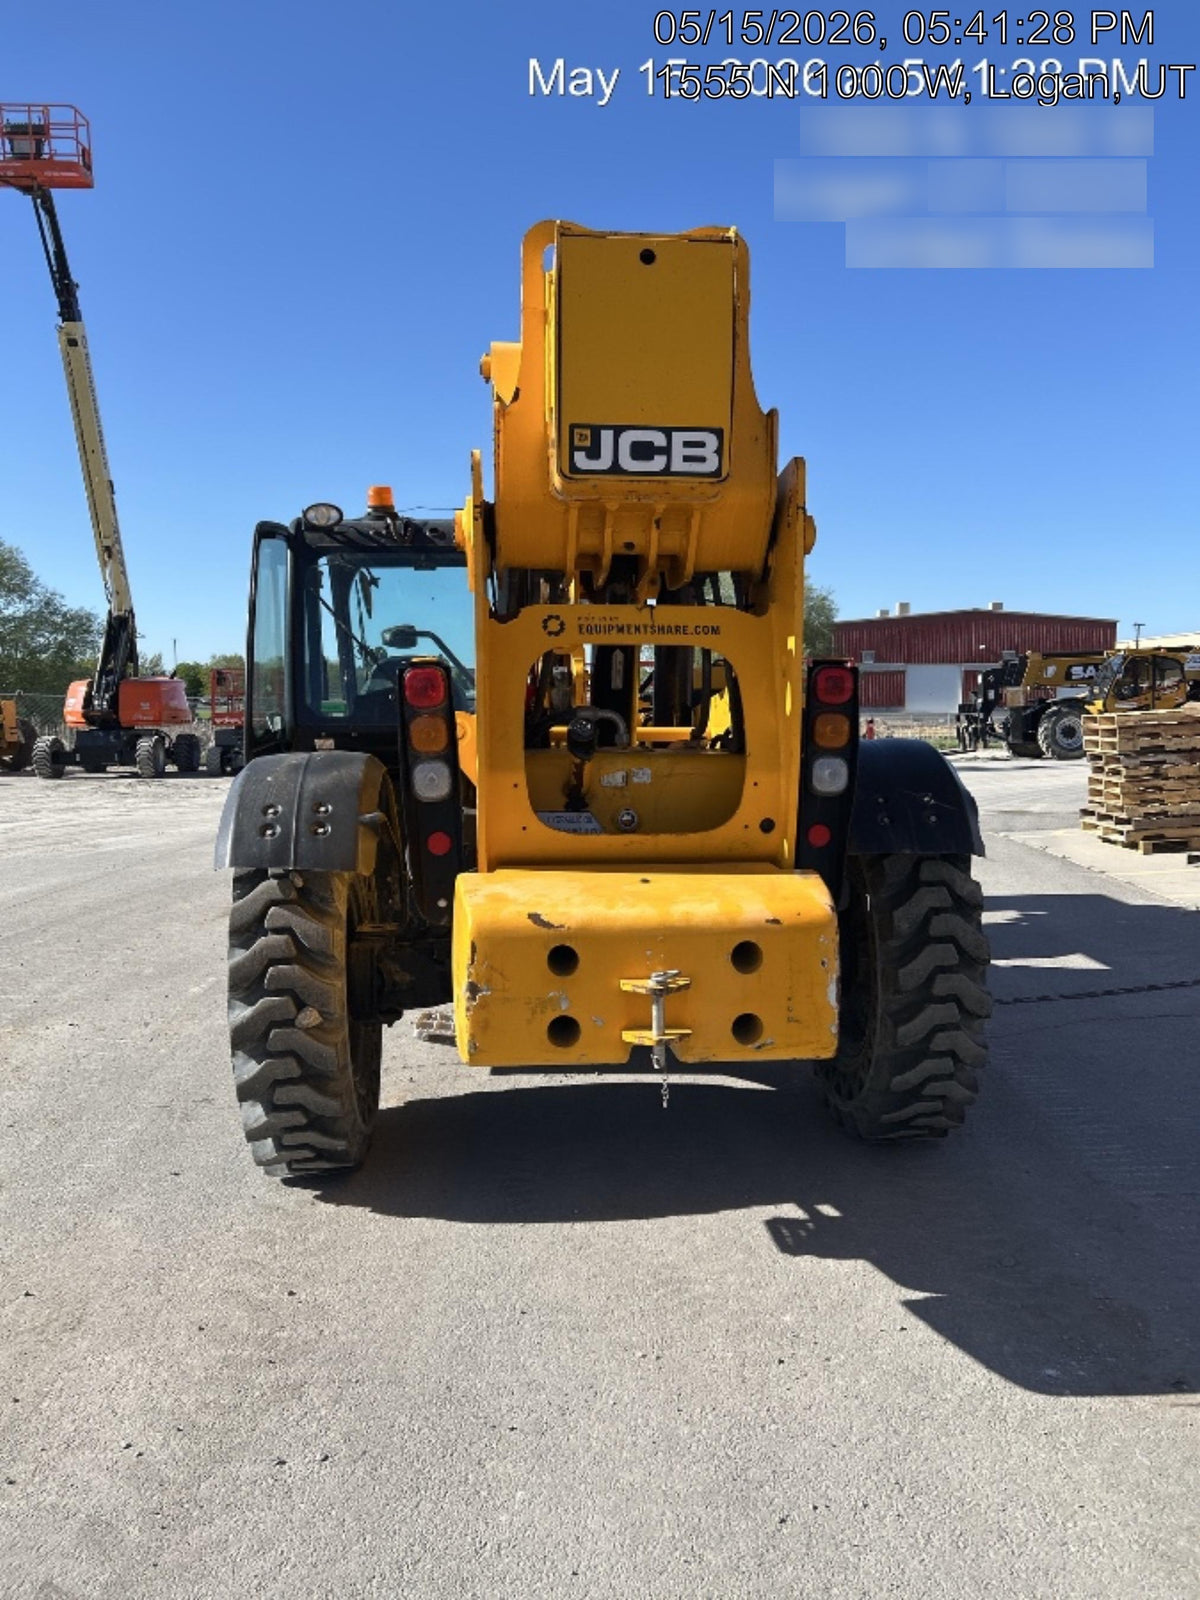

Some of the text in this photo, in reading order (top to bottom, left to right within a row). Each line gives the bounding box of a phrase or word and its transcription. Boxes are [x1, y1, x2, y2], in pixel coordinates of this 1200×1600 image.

[573, 429, 720, 473] JCB
[577, 623, 721, 636] EQUIPMENTSHARE.COM
[1070, 665, 1097, 680] SA
